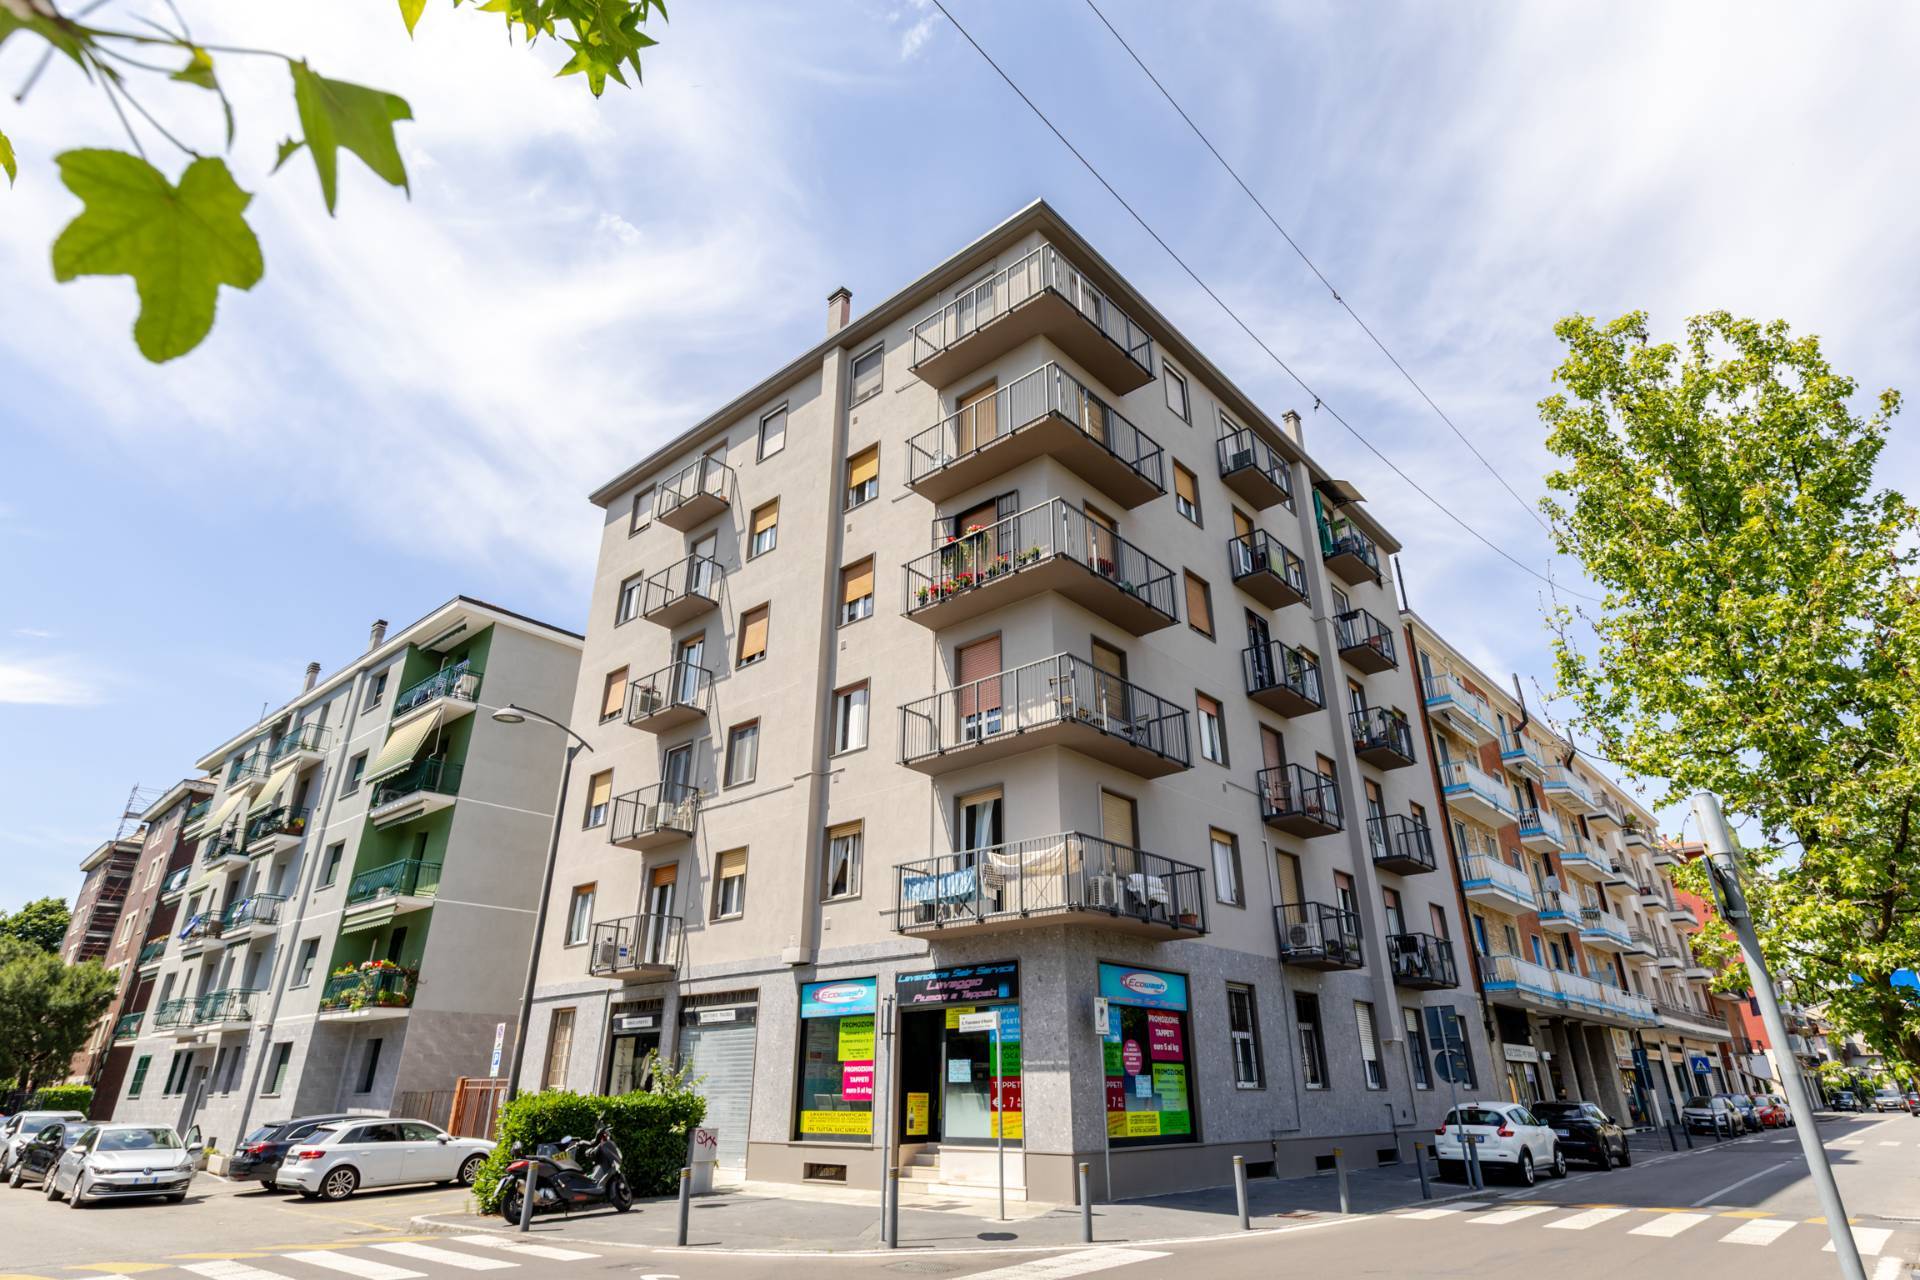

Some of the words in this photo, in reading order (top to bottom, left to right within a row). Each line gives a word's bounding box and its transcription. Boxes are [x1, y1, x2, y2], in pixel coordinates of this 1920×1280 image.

[926, 978, 983, 991] Lavaggio
[1129, 979, 1165, 991] Ecowash
[1148, 1015, 1180, 1025] PROMOZIONE
[1155, 1029, 1175, 1037] TAPPETI
[1155, 1068, 1184, 1076] PROMOZIONE
